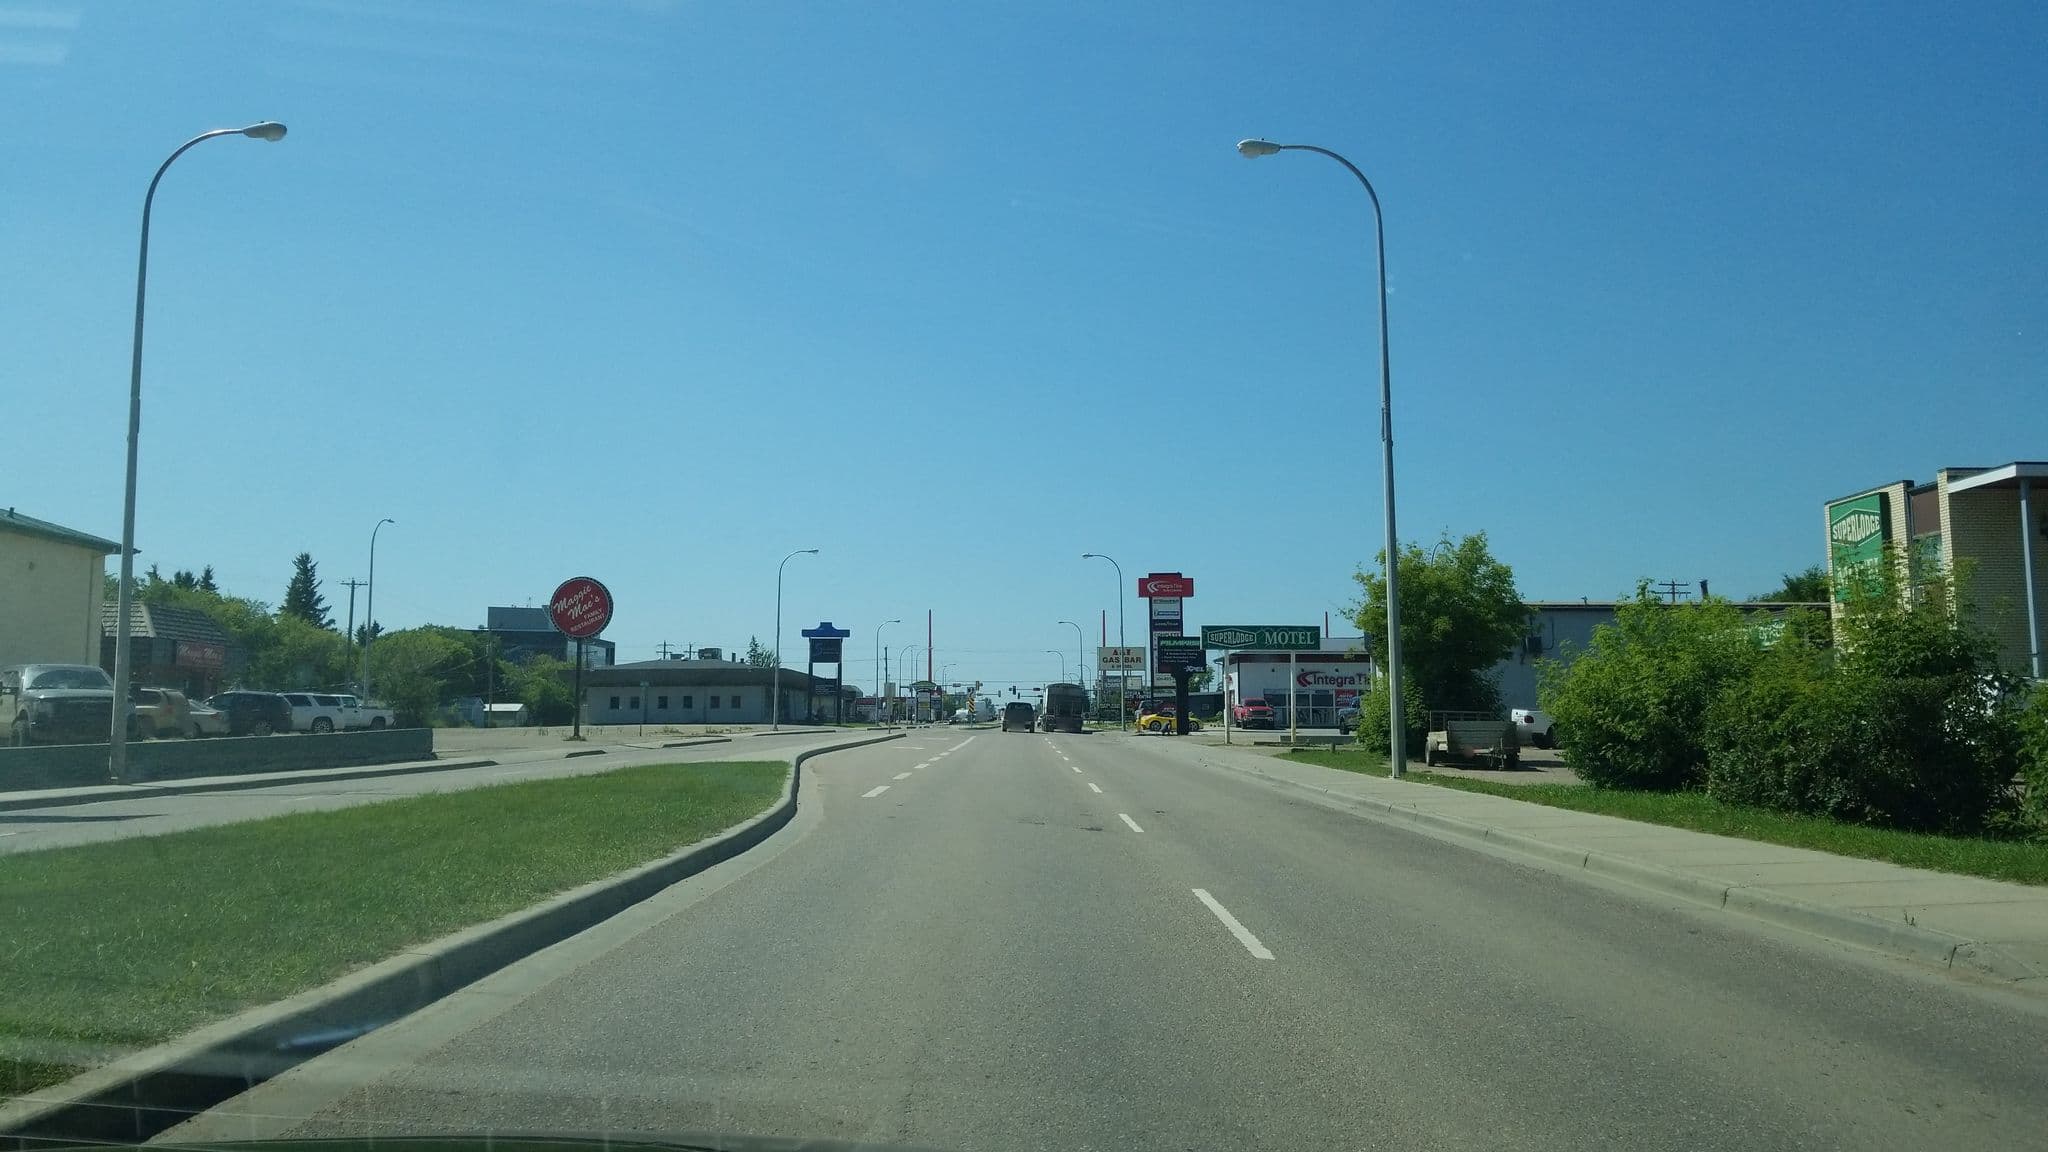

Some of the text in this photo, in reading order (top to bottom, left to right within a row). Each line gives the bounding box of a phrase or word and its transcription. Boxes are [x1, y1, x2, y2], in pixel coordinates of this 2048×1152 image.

[1832, 514, 1880, 542] SUPERLODGE
[553, 585, 592, 614] Maggie
[570, 613, 604, 631] RESTAURANT
[583, 608, 602, 620] FAMILY
[1210, 631, 1315, 645] SUPERLODGE MOTEL
[1313, 674, 1355, 687] Integra
